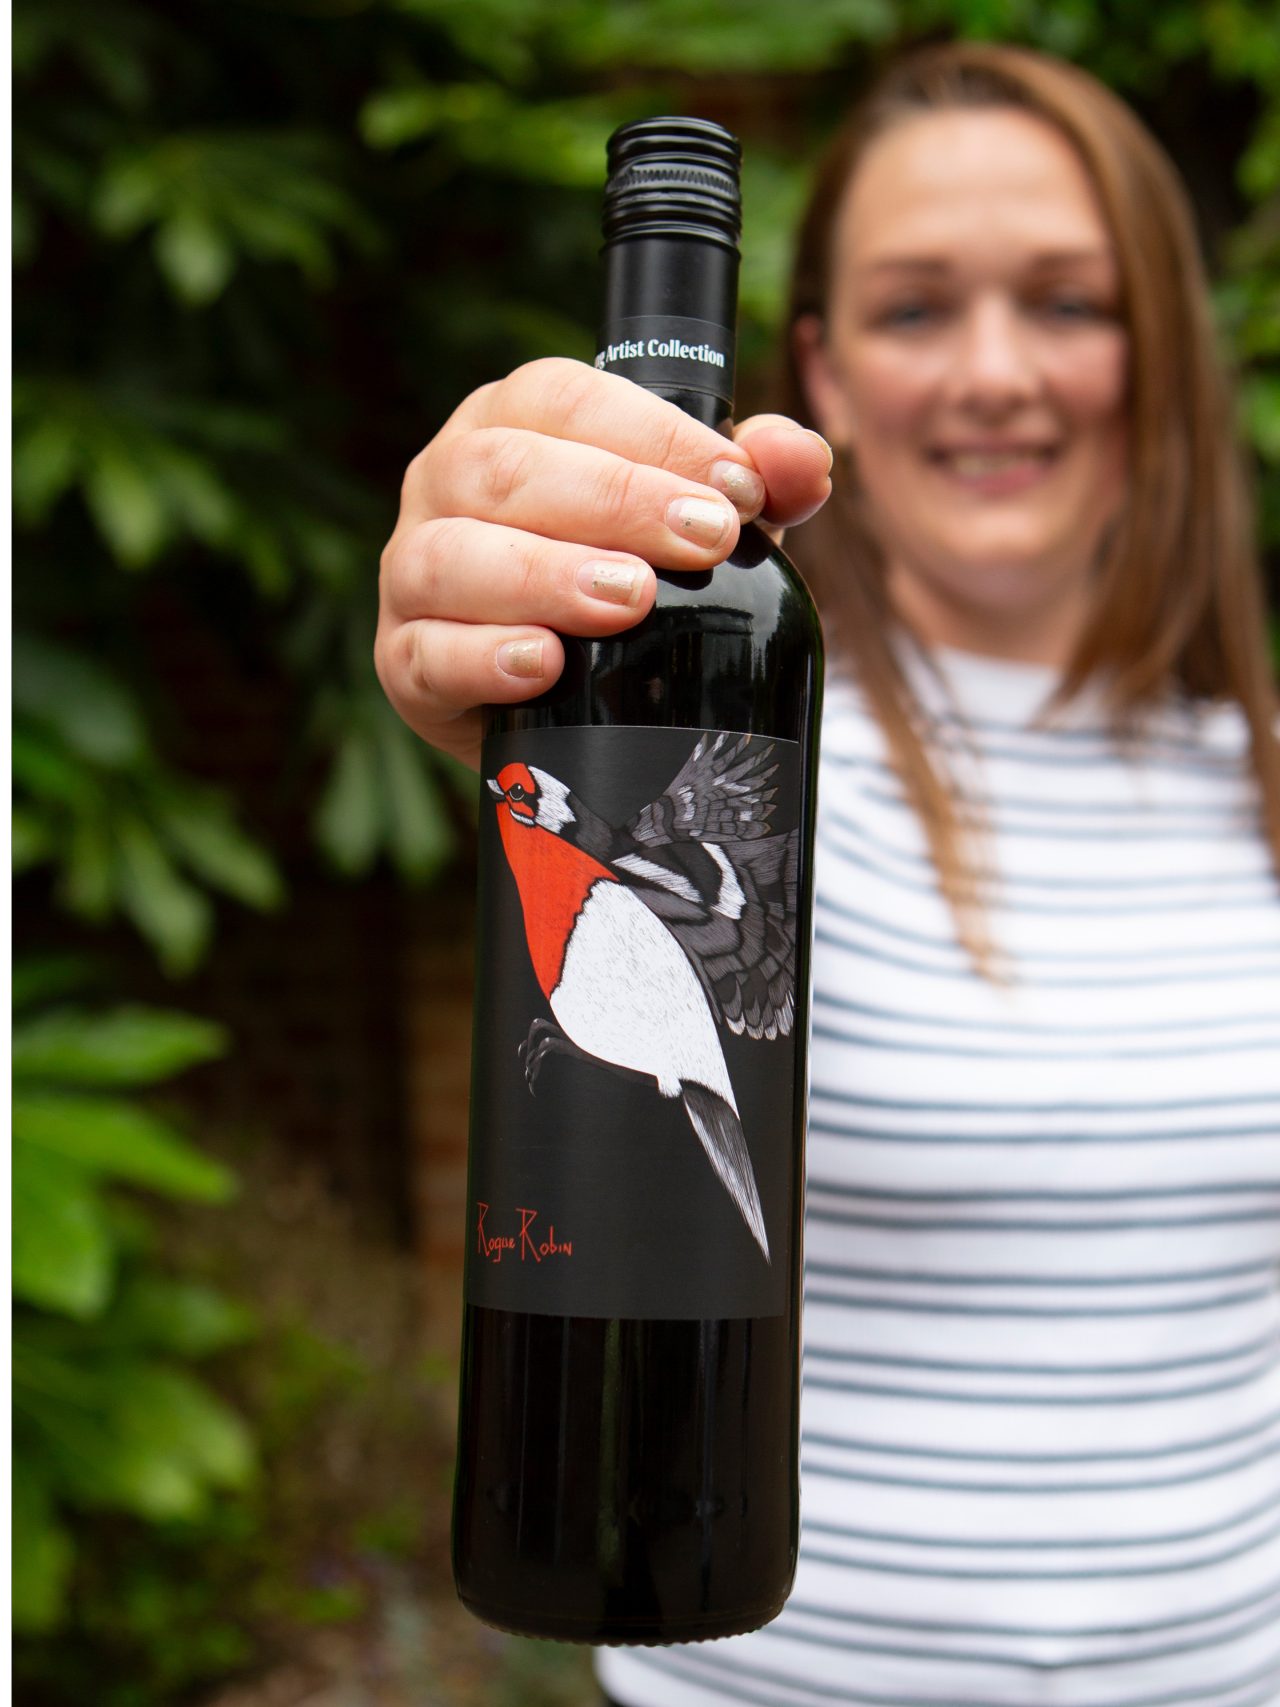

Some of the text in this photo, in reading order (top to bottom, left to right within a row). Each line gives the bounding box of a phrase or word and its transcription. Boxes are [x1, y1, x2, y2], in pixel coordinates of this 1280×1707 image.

[606, 340, 644, 362] Artist
[647, 338, 725, 368] Collection
[477, 1202, 516, 1263] Rogue
